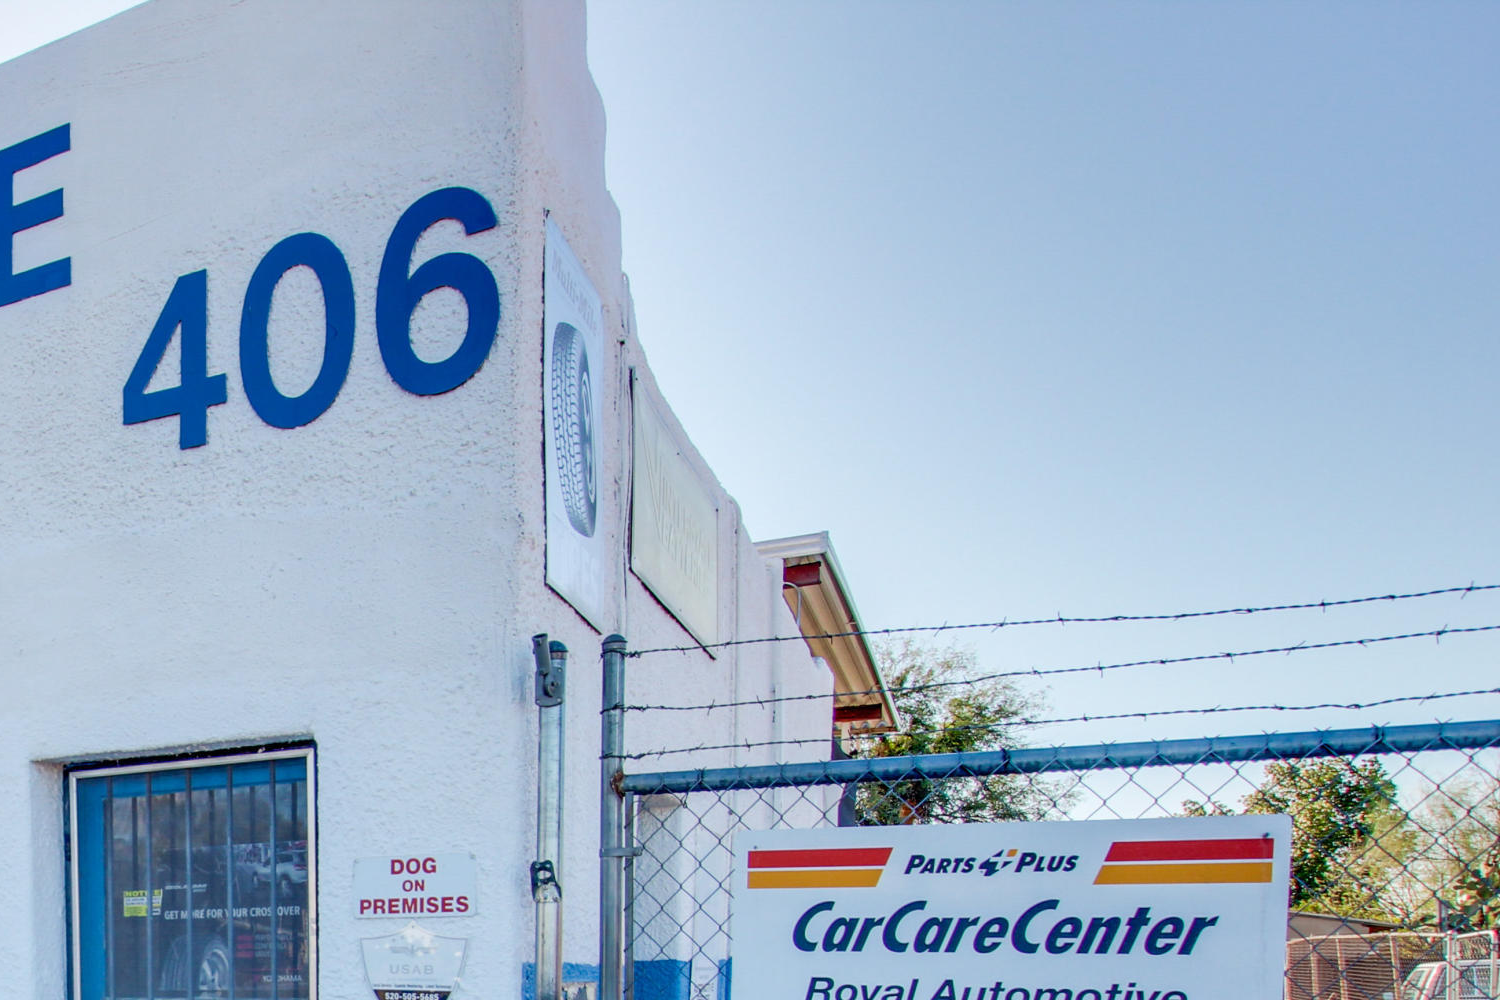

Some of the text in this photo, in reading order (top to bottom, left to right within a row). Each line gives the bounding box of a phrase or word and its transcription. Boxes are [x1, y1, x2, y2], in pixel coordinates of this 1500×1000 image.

[122, 186, 501, 451] 406
[390, 857, 437, 875] DOG
[904, 851, 1081, 876] PARTS PLUS
[402, 879, 426, 893] ON
[164, 910, 179, 921] GET
[180, 909, 205, 920] MRE
[206, 908, 223, 919] FOR
[251, 905, 301, 918] CROSOVER
[359, 896, 469, 915] PREMISES
